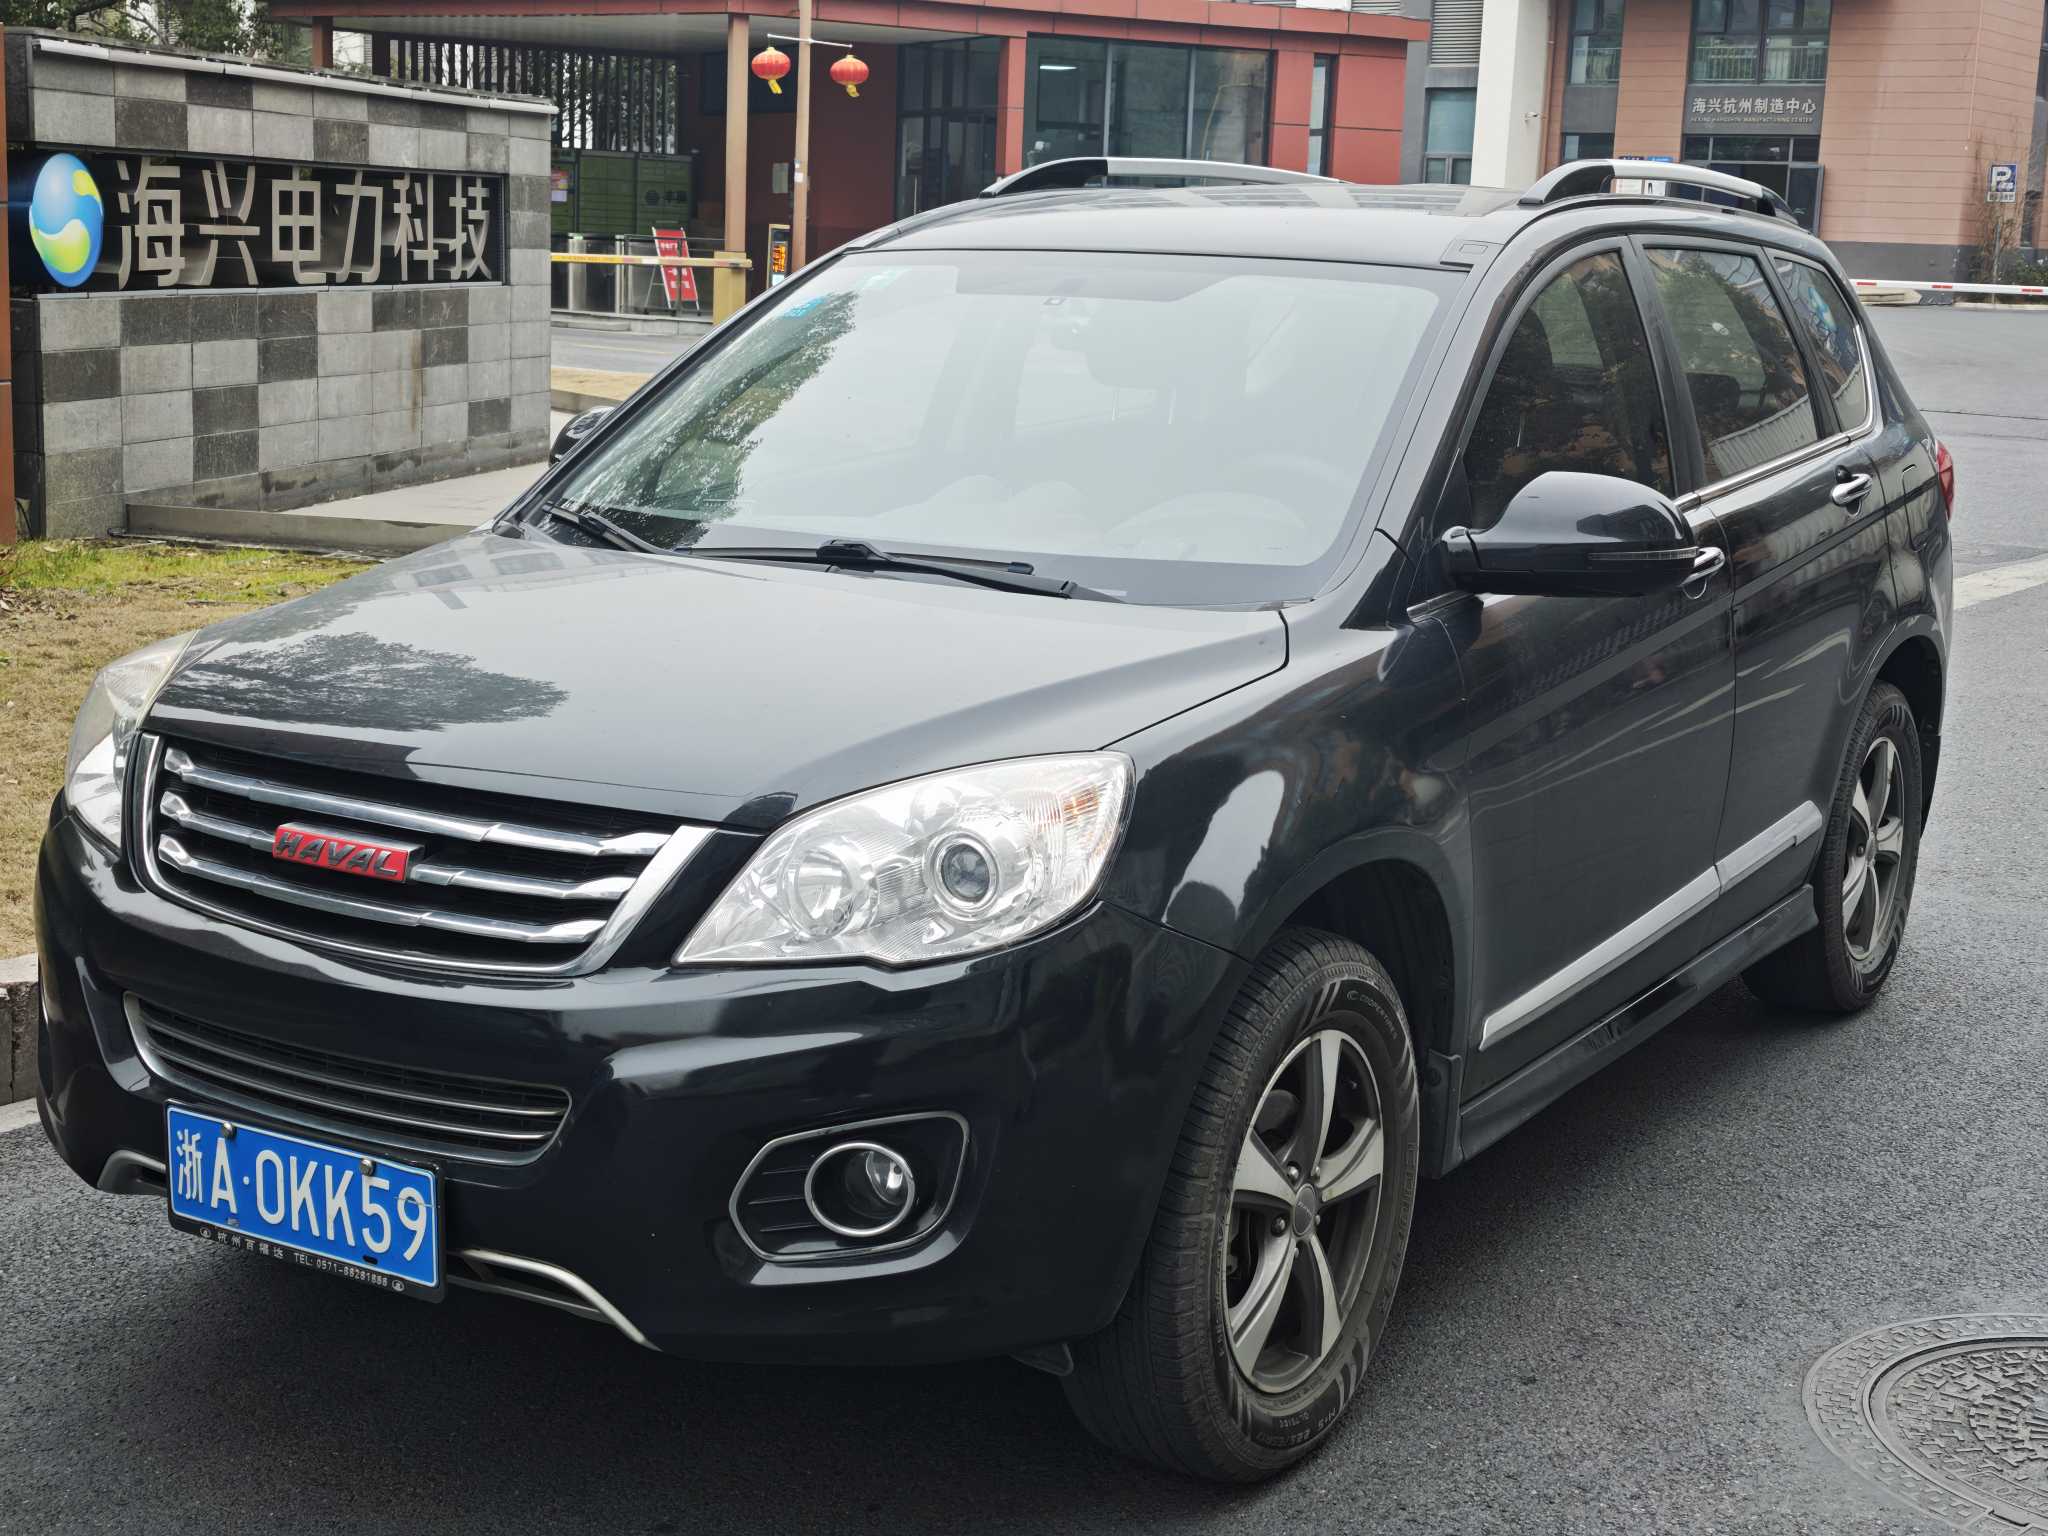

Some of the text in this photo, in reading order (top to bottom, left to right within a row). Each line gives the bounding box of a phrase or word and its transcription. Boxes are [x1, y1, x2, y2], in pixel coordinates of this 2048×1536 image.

[1692, 97, 1817, 114] 海兴杭州制造中心
[1991, 166, 2012, 192] P
[117, 157, 492, 290] 海兴电力科技
[275, 831, 398, 877] HAVAL
